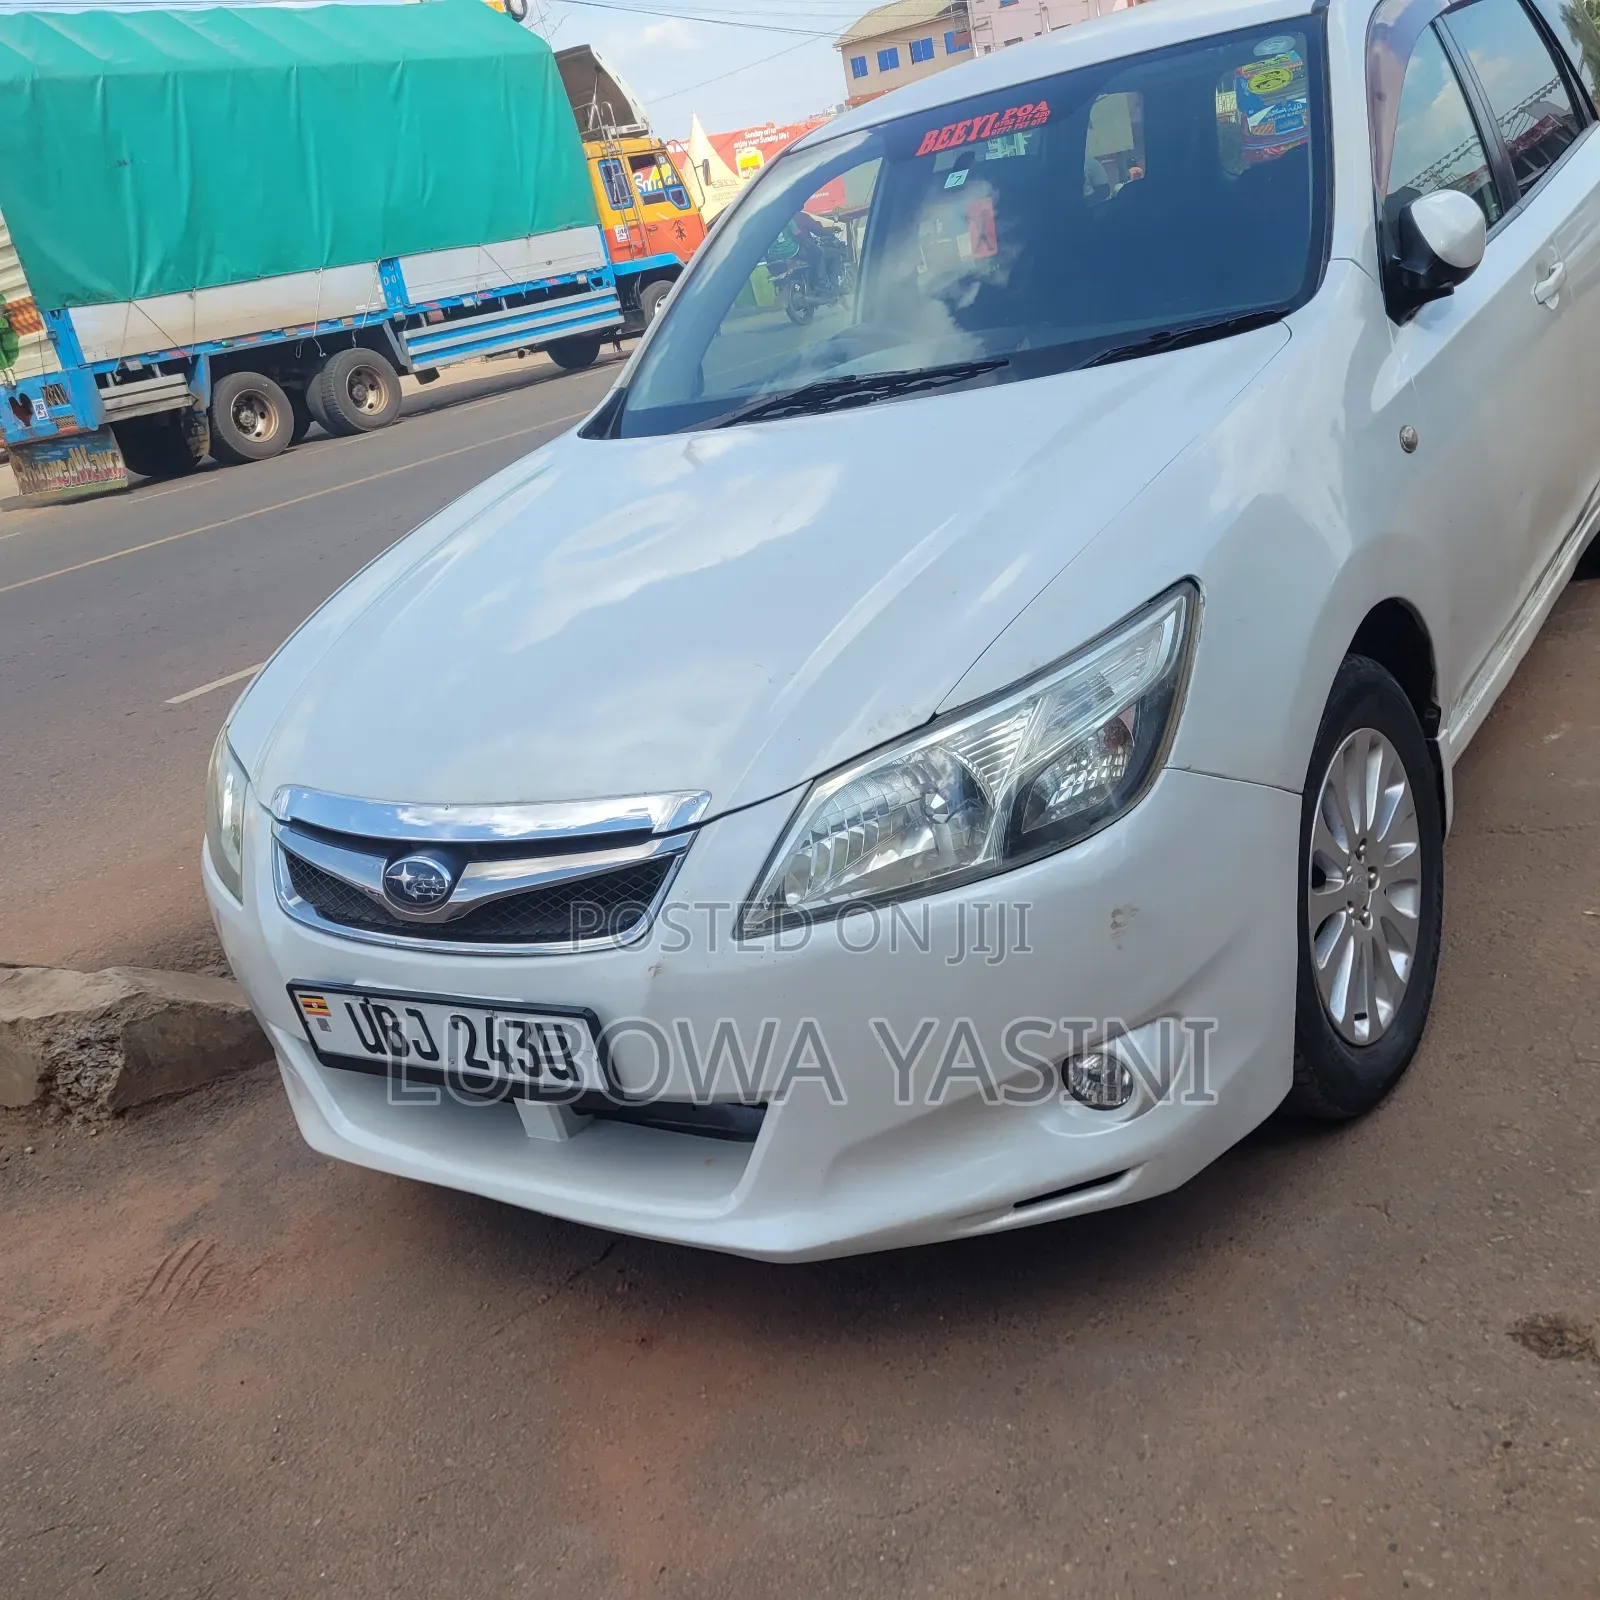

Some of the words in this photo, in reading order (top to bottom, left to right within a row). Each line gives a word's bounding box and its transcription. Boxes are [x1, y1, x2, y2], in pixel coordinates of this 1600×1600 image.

[744, 130, 764, 139] Sunday
[760, 134, 779, 143] Sunday
[915, 112, 1000, 156] BEEYI
[1002, 100, 1049, 120] POA
[344, 1000, 440, 1062] UBJ
